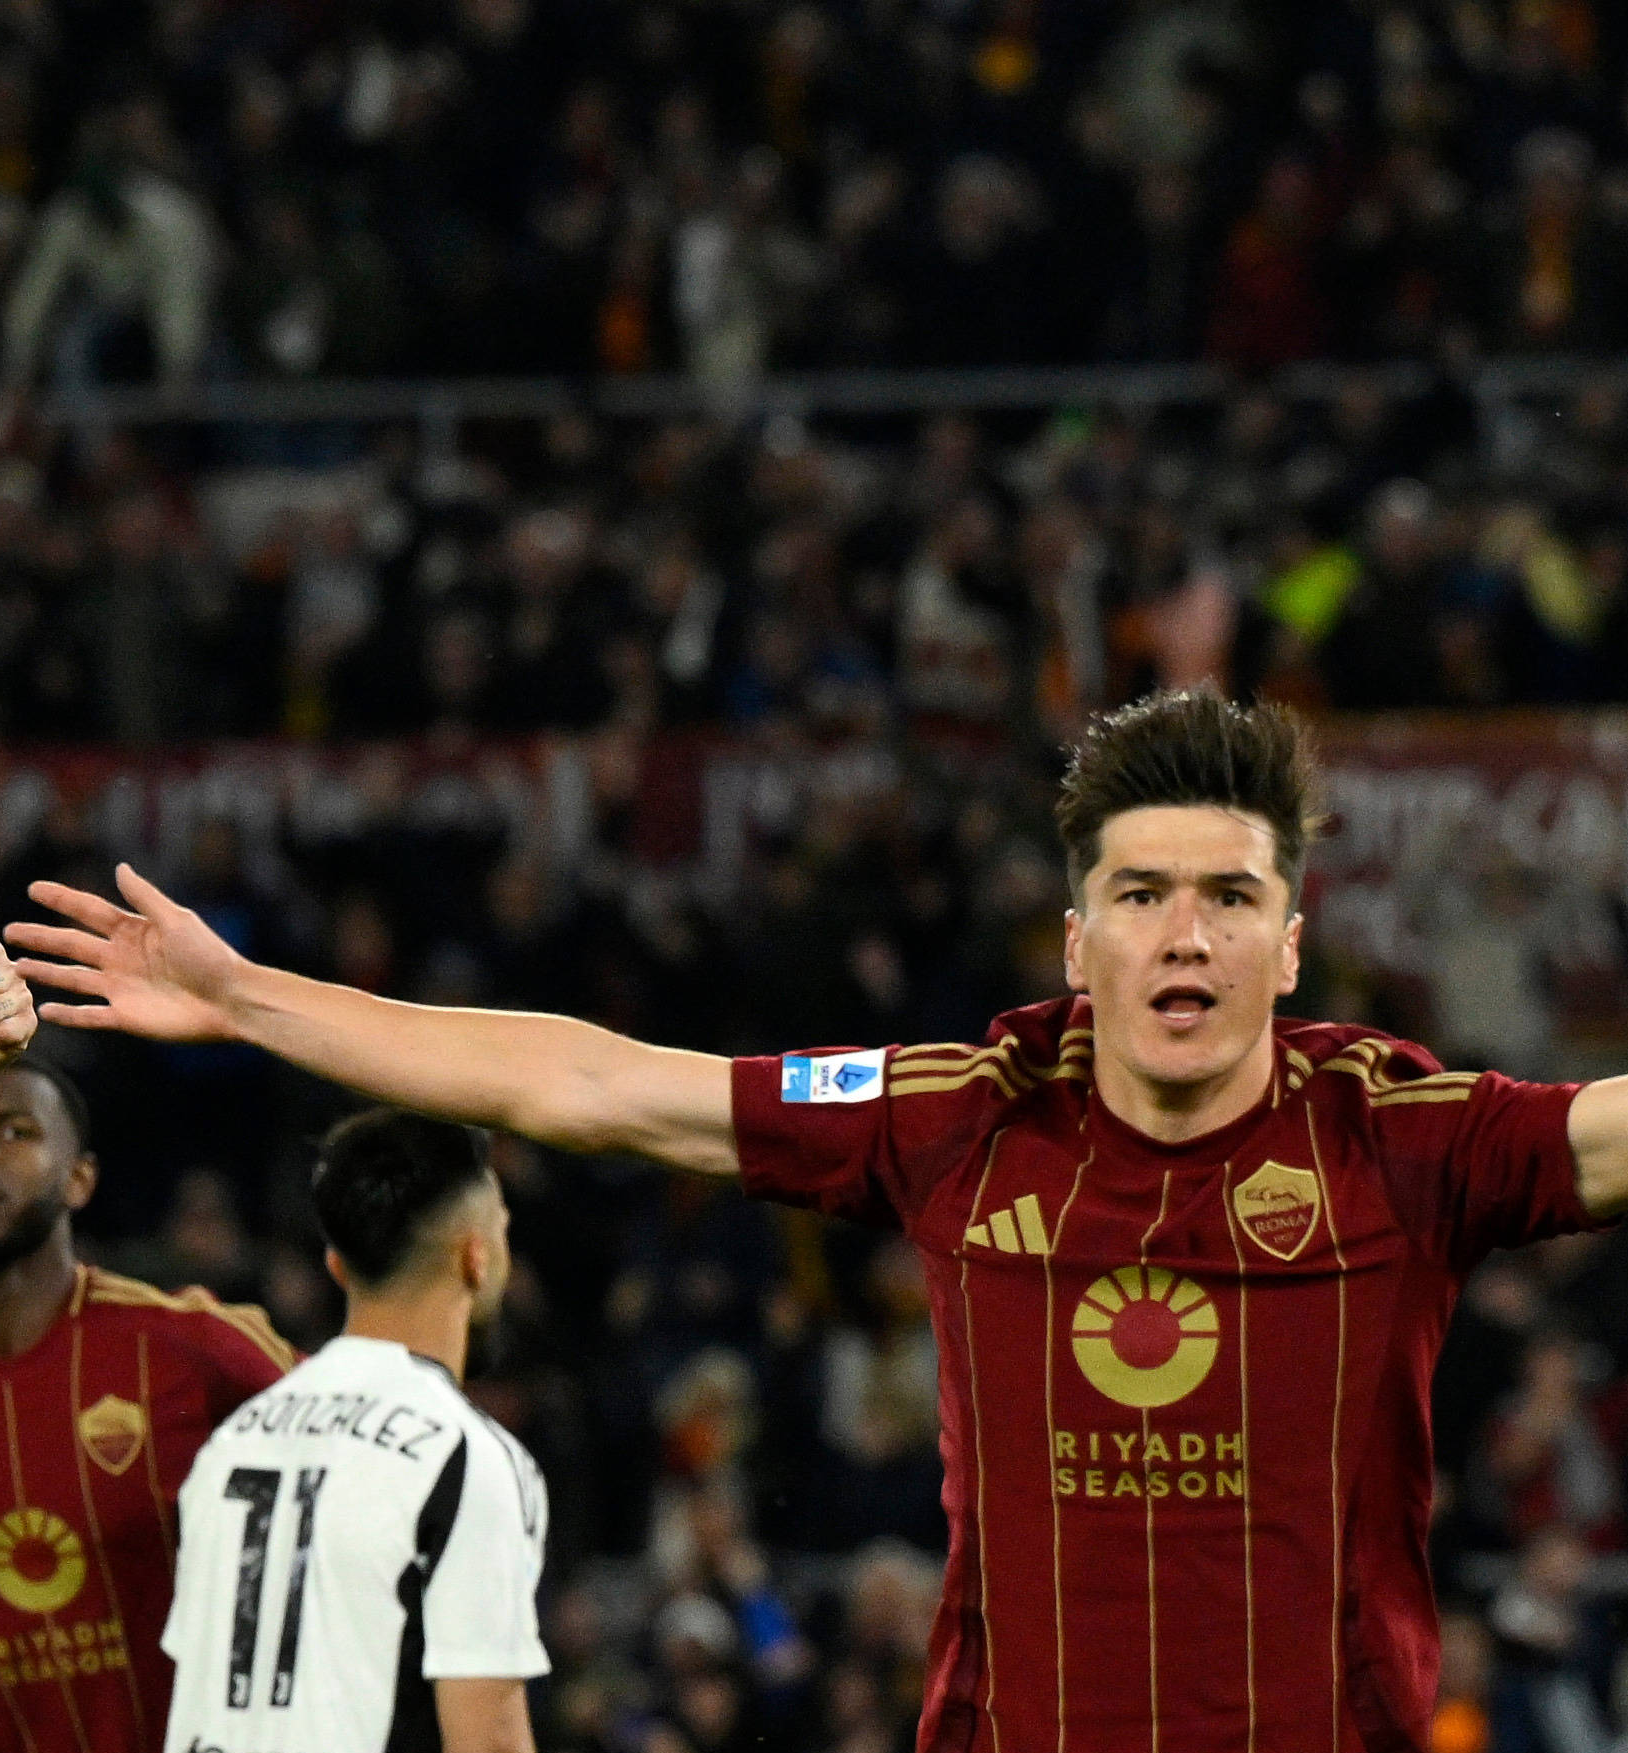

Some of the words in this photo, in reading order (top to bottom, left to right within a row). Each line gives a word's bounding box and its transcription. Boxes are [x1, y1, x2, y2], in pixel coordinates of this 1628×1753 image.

[1055, 1430, 1243, 1462] RIYADH
[1056, 1467, 1244, 1499] SEASON
[223, 1467, 327, 1709] 11
